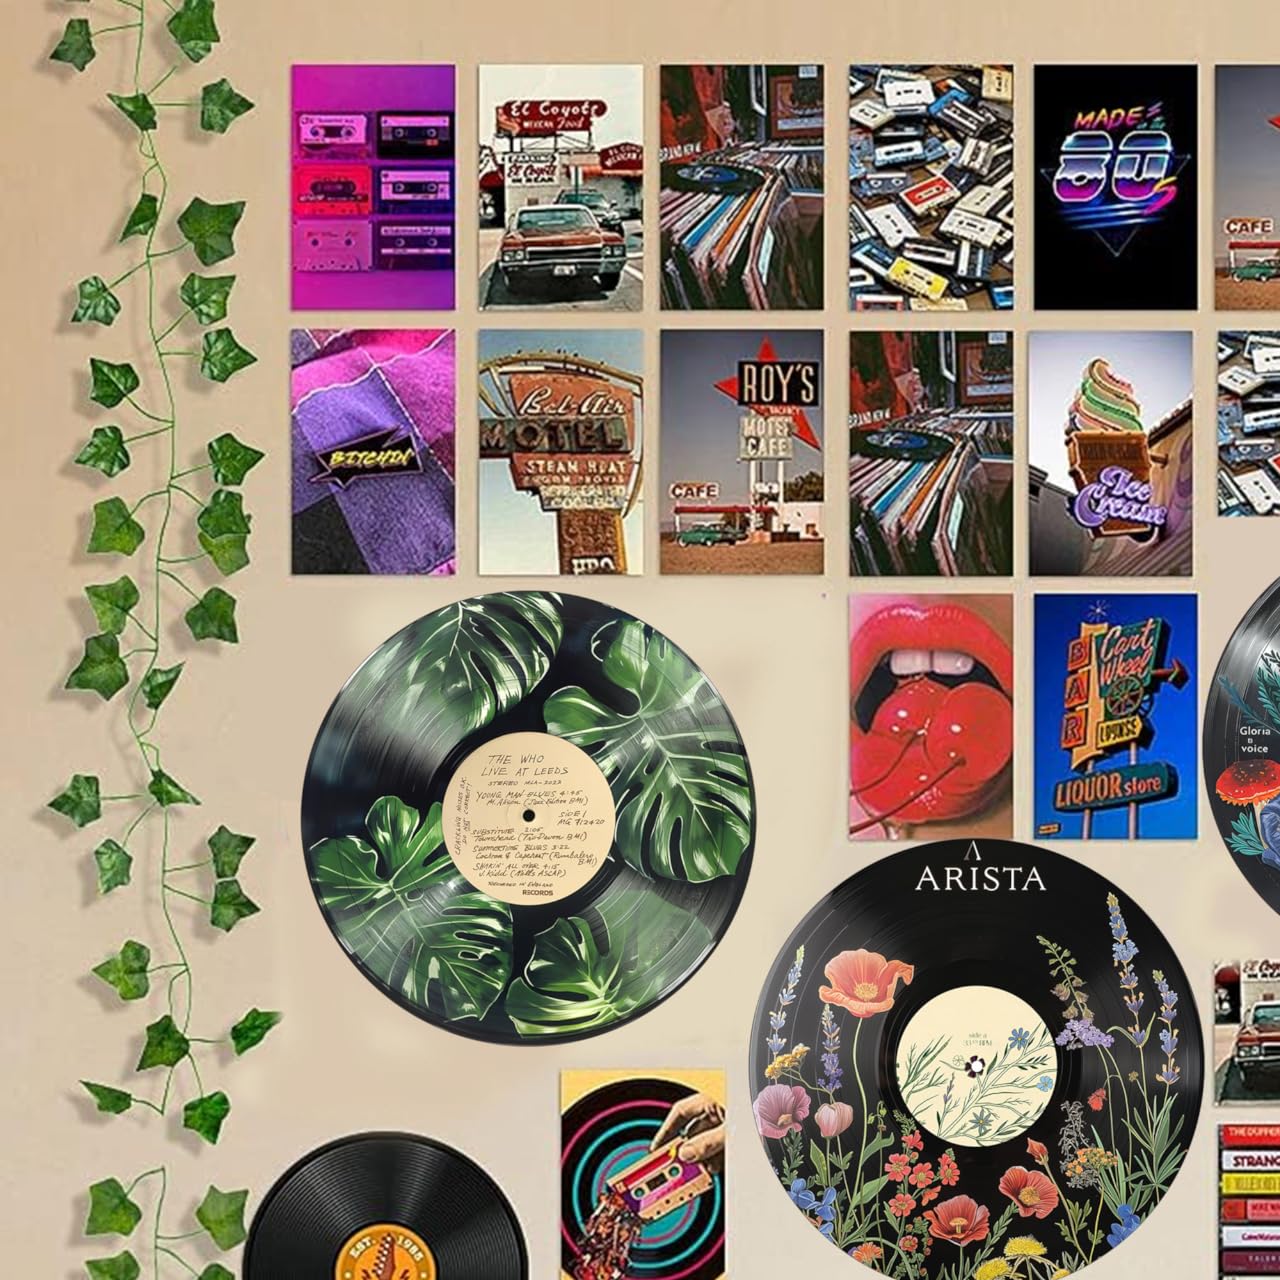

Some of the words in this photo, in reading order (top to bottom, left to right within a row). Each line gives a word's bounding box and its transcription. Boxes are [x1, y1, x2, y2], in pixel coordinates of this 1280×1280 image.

[538, 101, 600, 118] Coyote
[1074, 106, 1145, 130] MADE
[1226, 219, 1273, 234] CAFE
[743, 363, 814, 403] ROY'S
[480, 420, 625, 449] MOTEL
[747, 438, 787, 456] CAFE
[670, 484, 718, 499] CAFE
[1100, 465, 1154, 502] Ice
[1074, 483, 1168, 527] Cream
[1100, 617, 1156, 662] Cart
[1240, 726, 1271, 736] Gloria
[1241, 744, 1269, 752] voice
[488, 754, 512, 765] THE
[520, 754, 545, 764] WHO
[515, 767, 529, 776] AT
[533, 766, 569, 776] LEEDS
[1056, 772, 1122, 808] LIQUOR
[1124, 776, 1161, 796] store
[914, 865, 1047, 892] ARISTA
